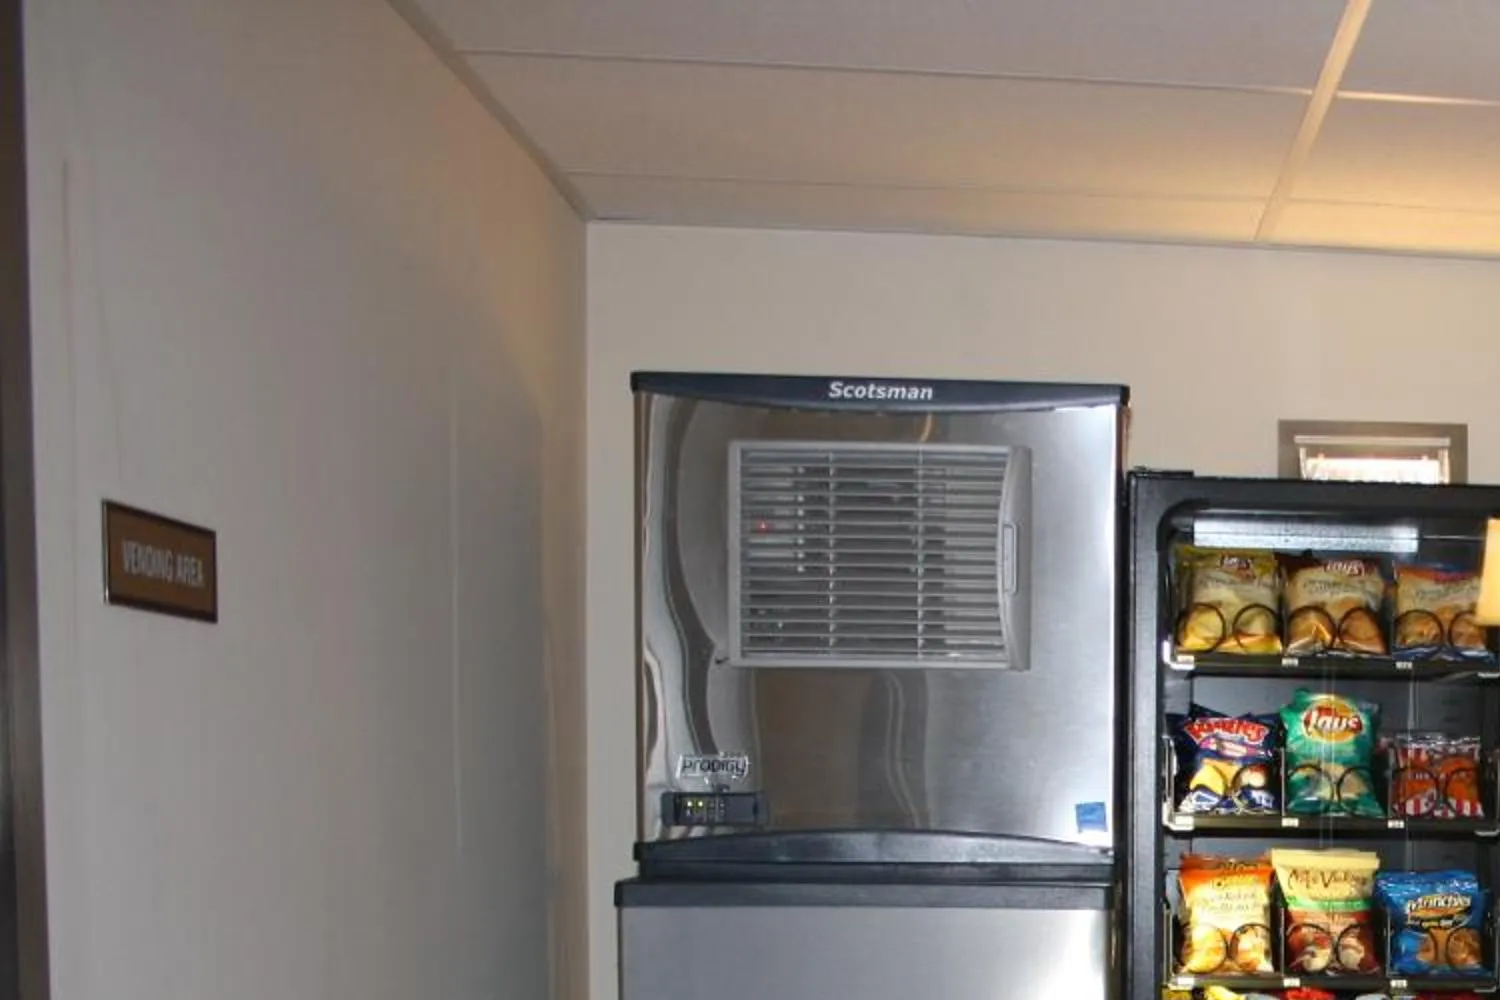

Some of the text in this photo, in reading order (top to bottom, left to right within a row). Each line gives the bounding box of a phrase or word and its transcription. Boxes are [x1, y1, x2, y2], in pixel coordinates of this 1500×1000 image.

[828, 381, 934, 401] Scotsman
[121, 538, 205, 588] VENDING AREA
